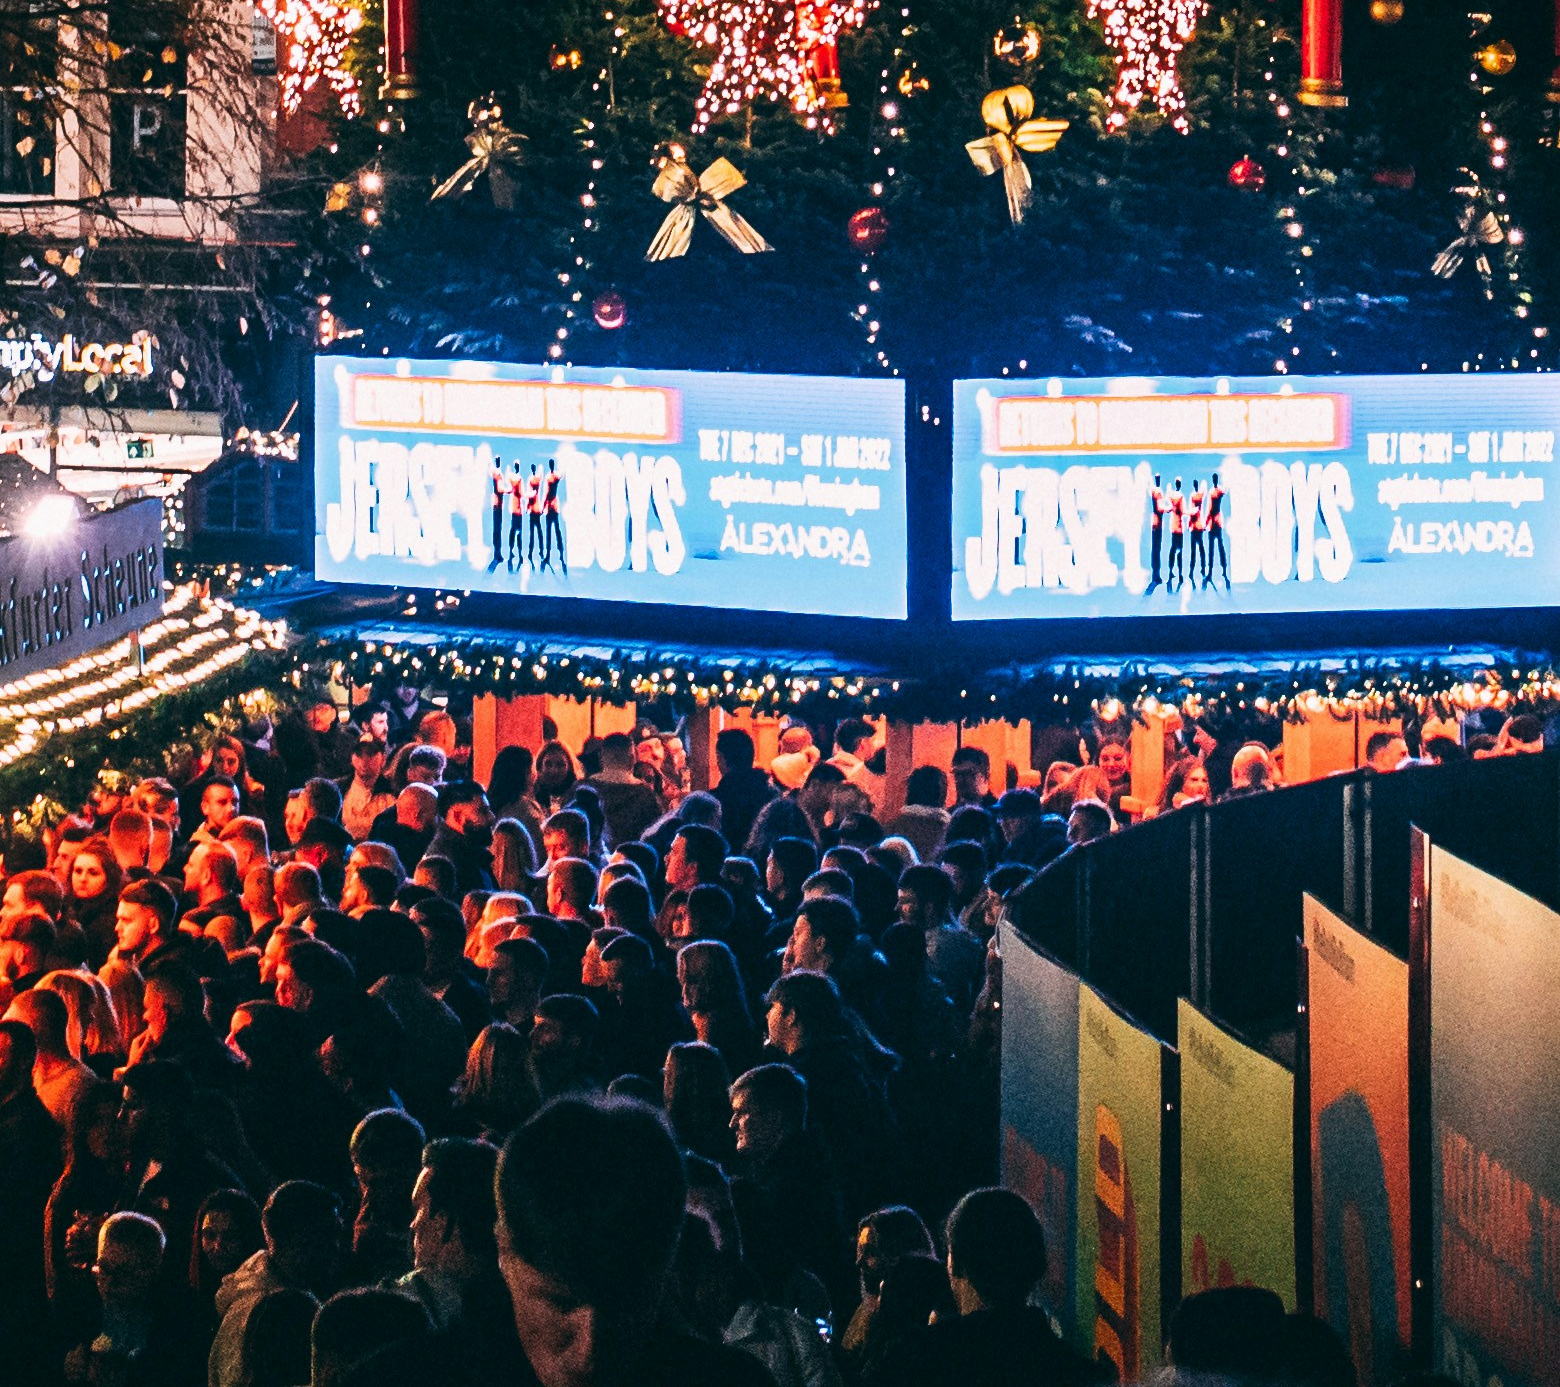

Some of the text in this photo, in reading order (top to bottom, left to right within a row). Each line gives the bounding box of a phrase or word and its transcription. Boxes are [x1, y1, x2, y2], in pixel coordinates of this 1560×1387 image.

[326, 436, 687, 576] JERSEY BOYS
[965, 456, 1355, 599] JERSEY BOYS
